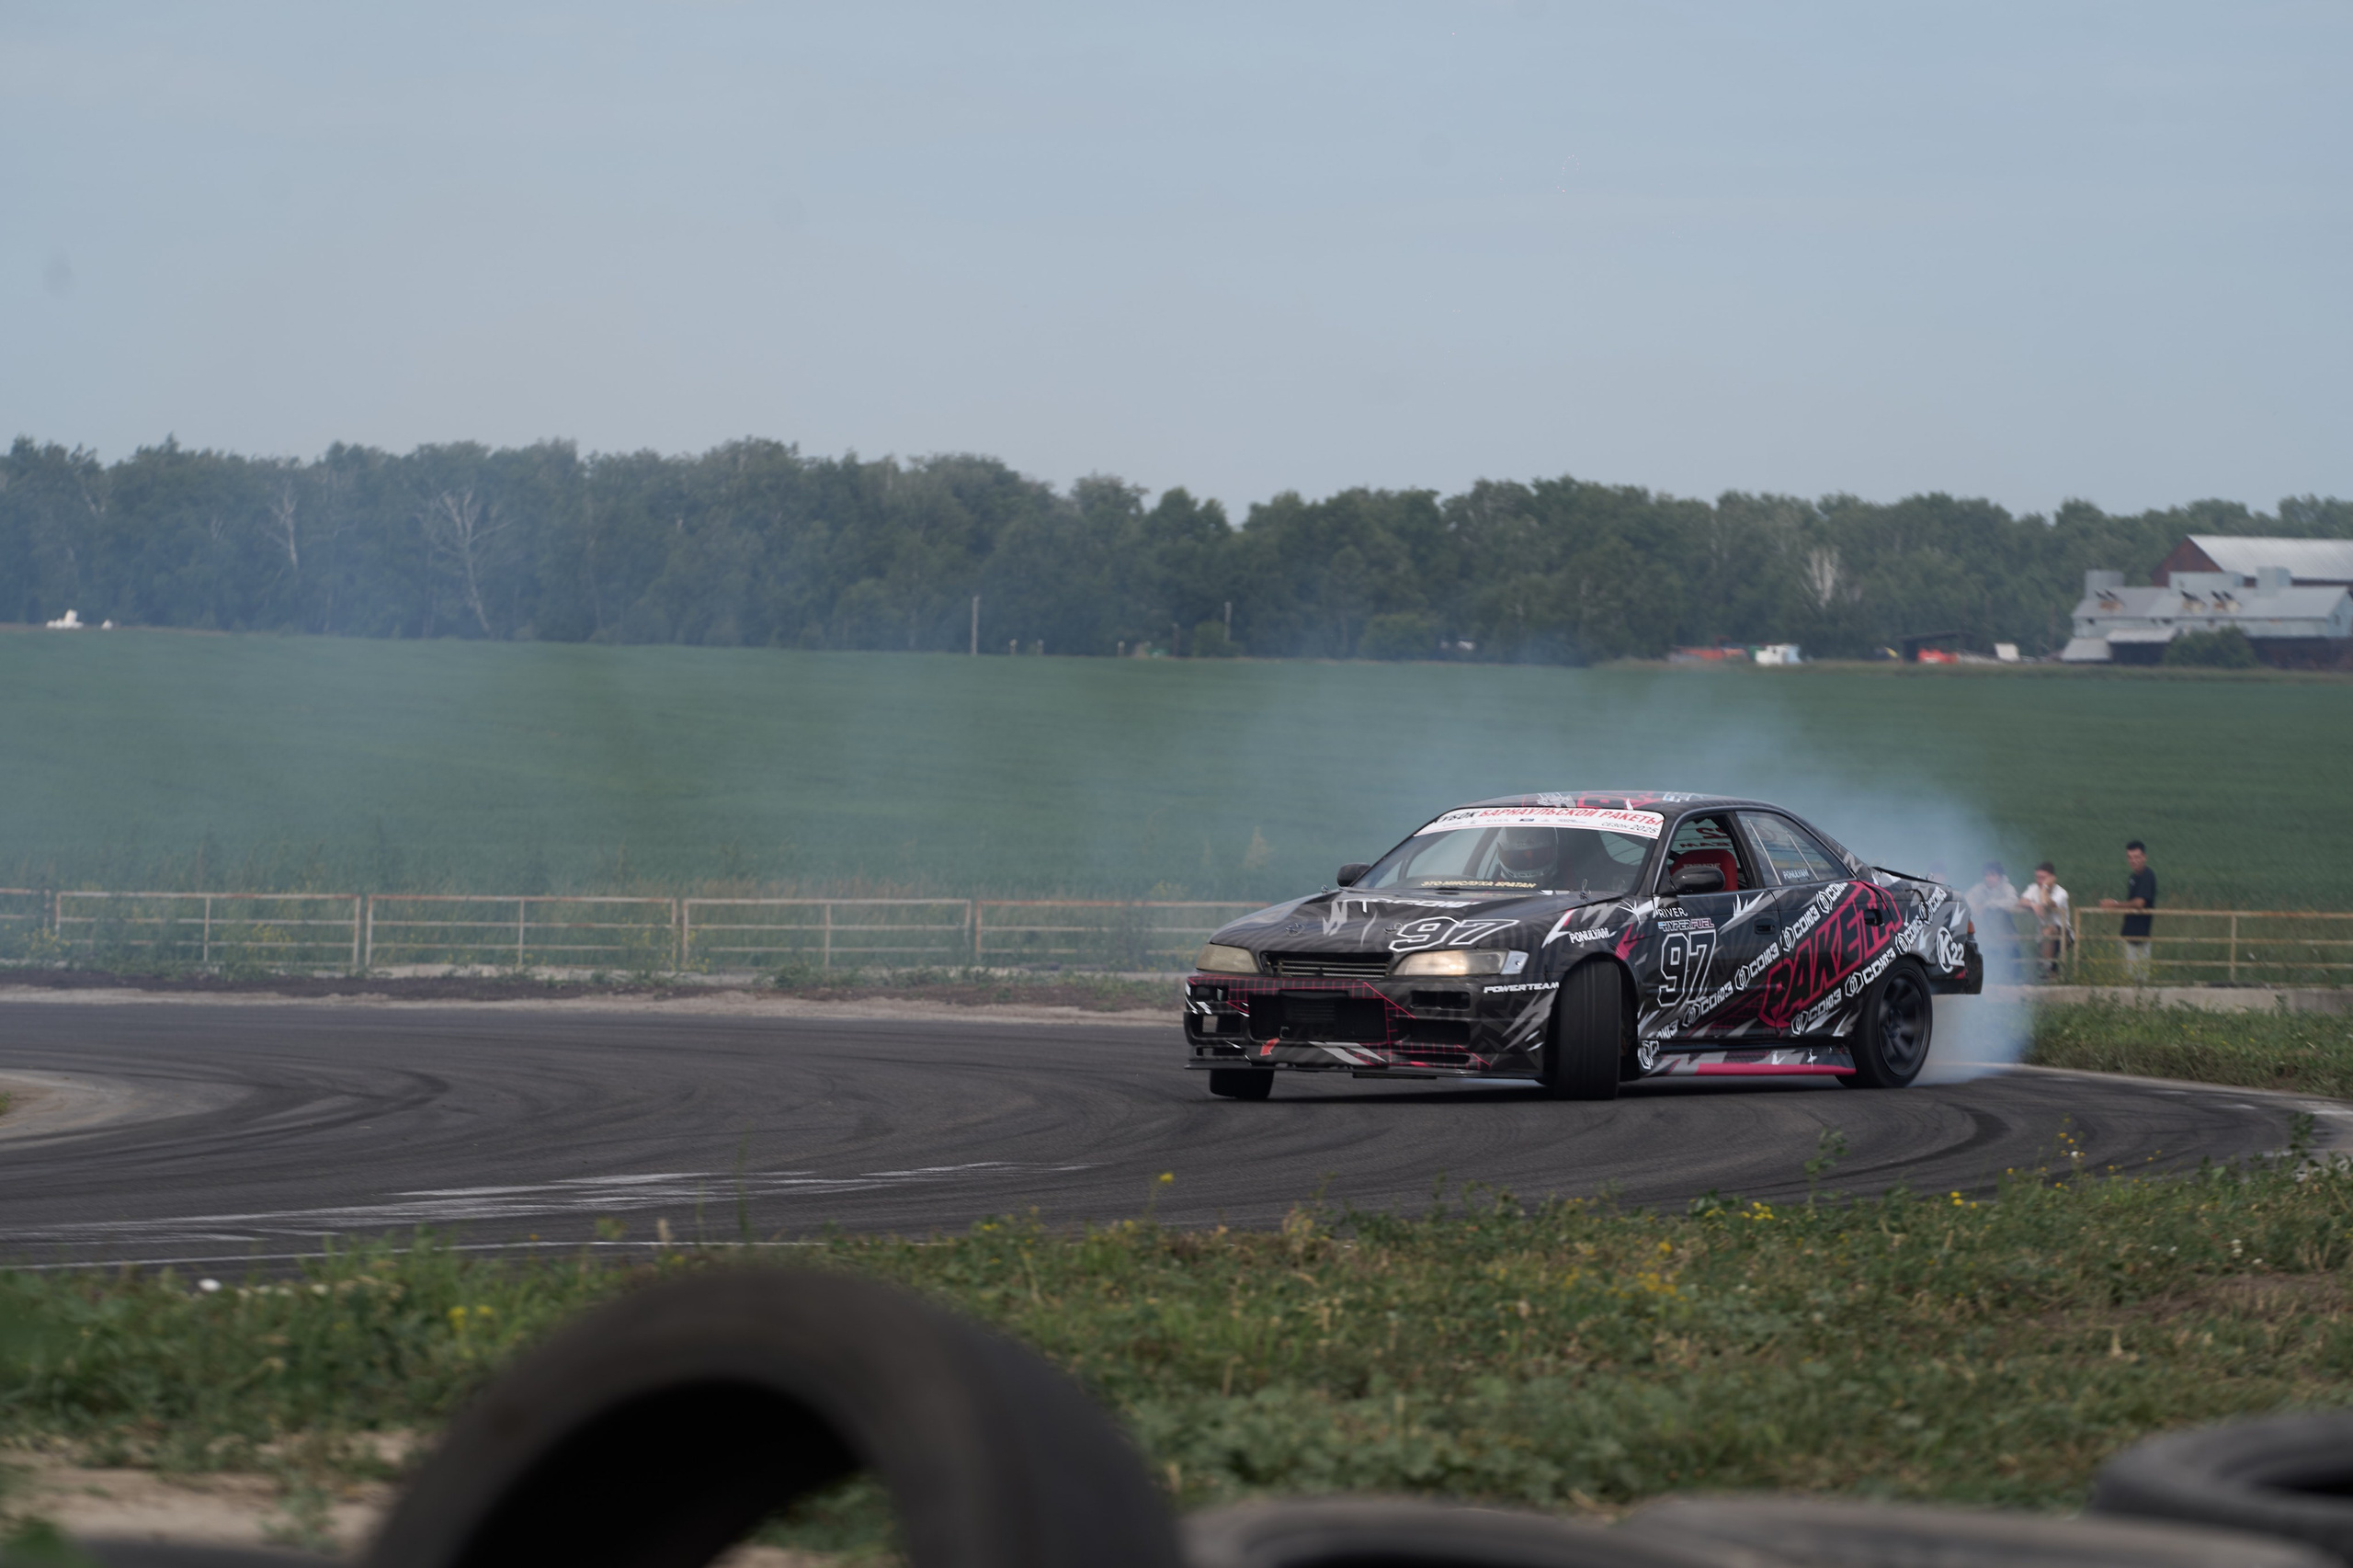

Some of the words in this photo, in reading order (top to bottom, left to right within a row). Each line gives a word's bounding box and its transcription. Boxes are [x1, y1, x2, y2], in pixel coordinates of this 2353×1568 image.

[1479, 808, 1599, 818] БАРНАУЛЬСКОЙ
[1599, 810, 1665, 825] РАКЕТЫ
[1630, 824, 1658, 834] 2025
[1659, 907, 1688, 918] RIVER
[1750, 942, 1780, 978] СОЮЗ
[1792, 904, 1821, 939] СОЮЗ
[1824, 882, 1848, 903] СОЮ
[1389, 916, 1520, 952] 97
[1657, 929, 1716, 1007] 97
[1862, 947, 1897, 984] СОЮЗ
